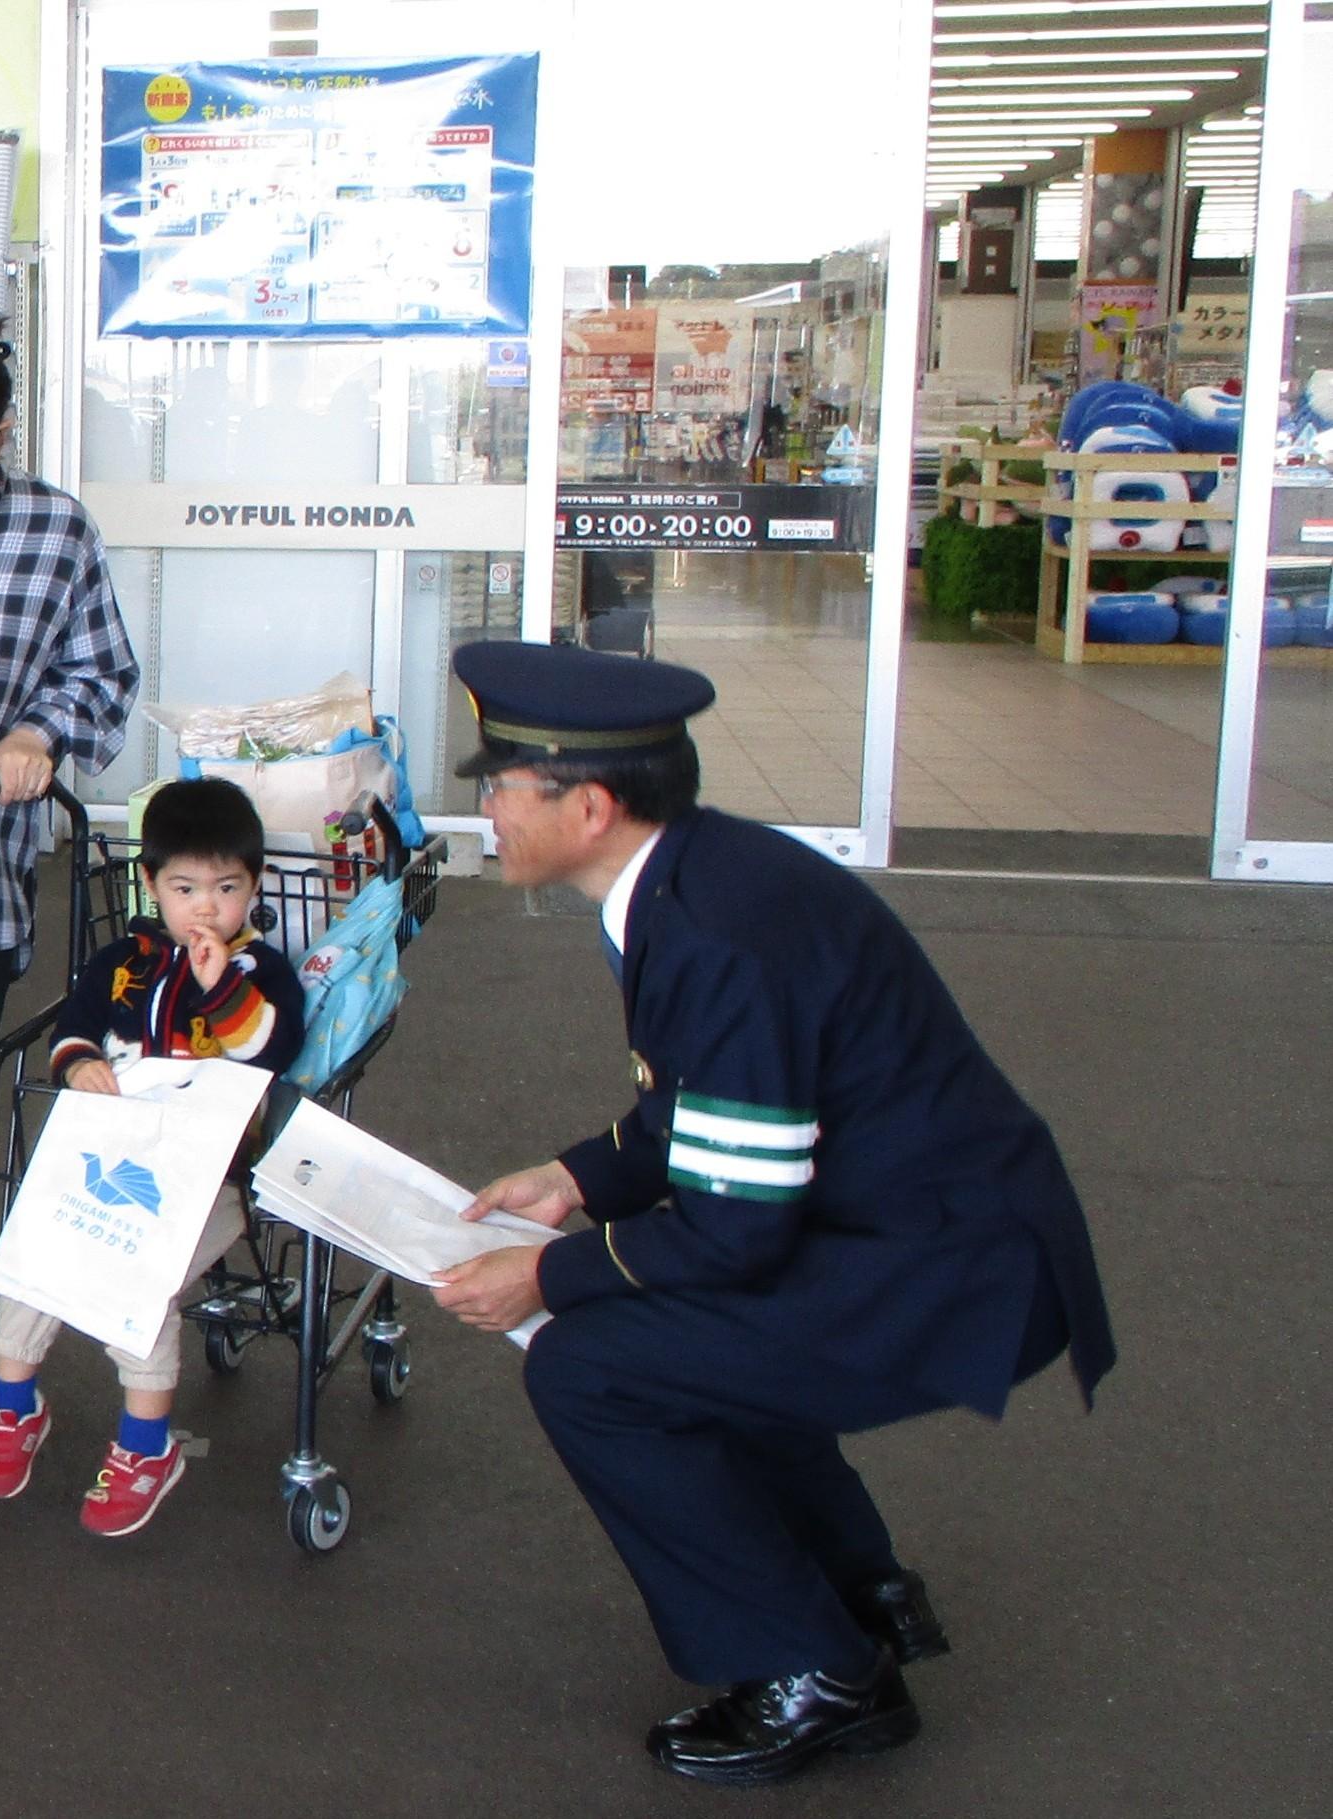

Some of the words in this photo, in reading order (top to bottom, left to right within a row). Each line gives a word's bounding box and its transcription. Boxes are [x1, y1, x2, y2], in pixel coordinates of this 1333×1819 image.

[185, 505, 296, 526] JOYFUL
[305, 506, 415, 527] HONDA
[52, 1208, 138, 1255] かみのかわ
